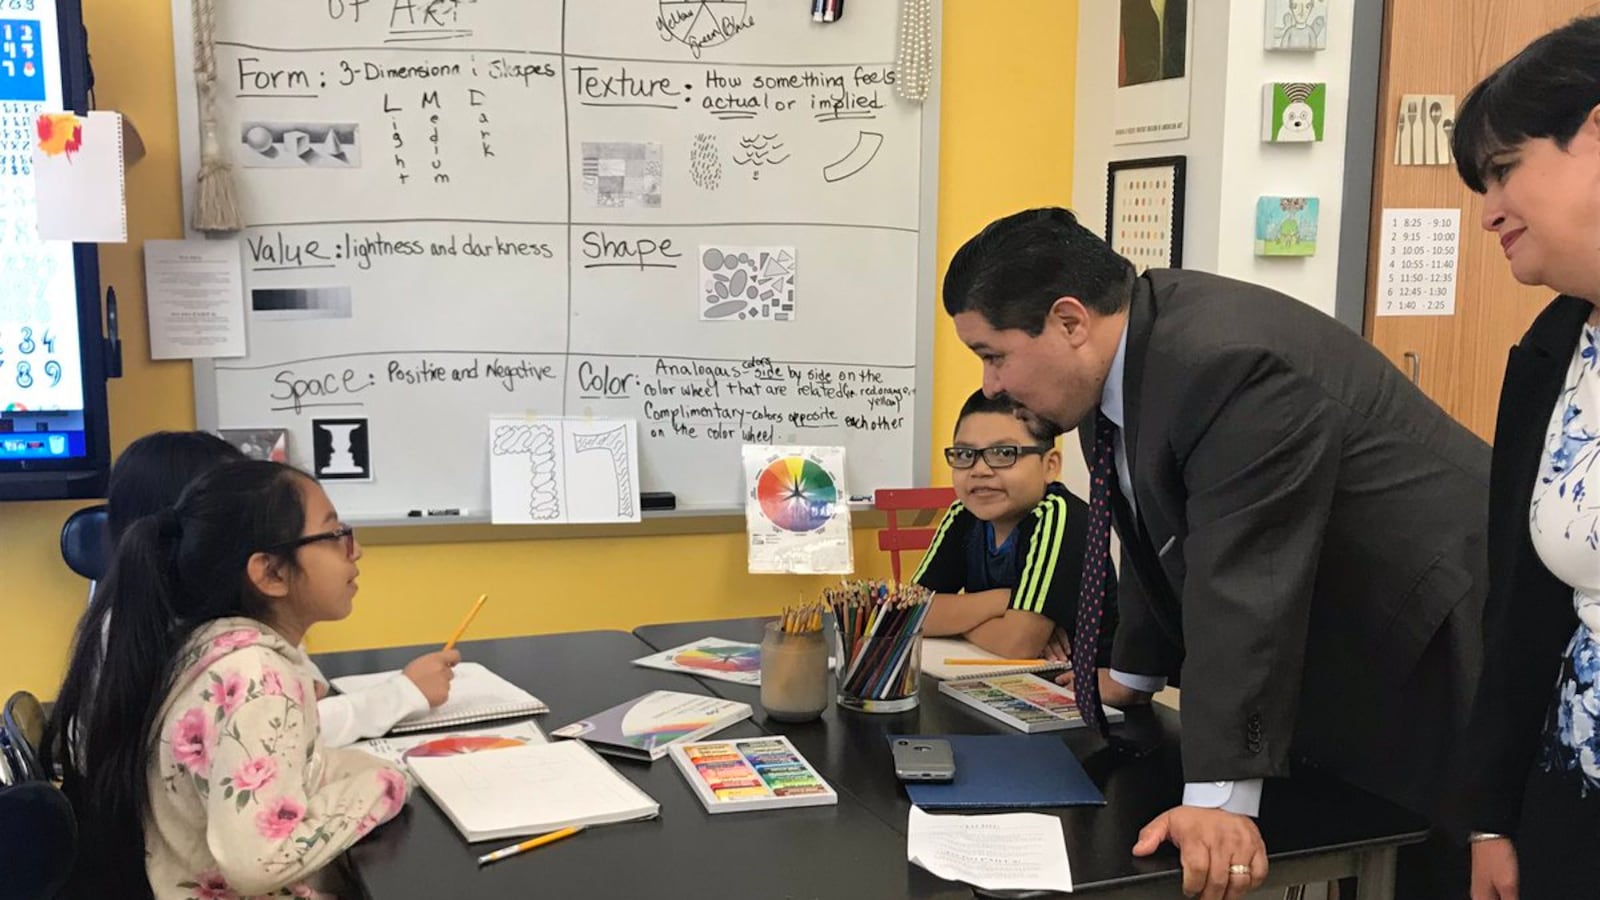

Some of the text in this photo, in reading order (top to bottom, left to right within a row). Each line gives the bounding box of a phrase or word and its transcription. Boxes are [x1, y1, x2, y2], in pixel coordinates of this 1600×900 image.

[706, 66, 896, 99] How something feels
[702, 90, 884, 118] actual or implied
[1393, 219, 1397, 227] 1
[1403, 219, 1422, 227] 8:25
[1433, 219, 1452, 227] 9:10
[430, 235, 457, 256] and
[462, 233, 554, 258] darkness
[1391, 232, 1397, 241] 2
[1402, 232, 1421, 241] 9:15
[1433, 232, 1456, 241] 10:00
[582, 231, 682, 271] Shape
[1390, 246, 1396, 255] 3
[1402, 246, 1425, 255] 10:05
[1432, 246, 1455, 255] 10:50
[1389, 260, 1395, 269] 4
[1401, 260, 1424, 269] 10:55
[1431, 260, 1454, 269] 11:40
[1389, 273, 1394, 282] 5
[1400, 273, 1423, 282] 11:50
[1430, 273, 1453, 282] 12:35
[1387, 288, 1393, 296] 6
[1399, 288, 1422, 296] 12:45
[1429, 288, 1447, 296] 1:30
[1387, 301, 1393, 310] 7
[1399, 301, 1417, 310] 1:40
[1427, 301, 1445, 310] 2:25
[451, 358, 479, 379] and
[486, 358, 557, 392] Negative
[754, 366, 785, 379] side
[787, 365, 802, 386] by
[807, 368, 832, 381] side
[839, 371, 857, 381] on
[859, 368, 884, 384] the
[644, 379, 677, 396] color
[681, 379, 720, 397] wheel
[726, 380, 763, 397] that
[765, 385, 788, 396] are
[787, 406, 839, 428] opposite
[871, 415, 905, 431] other
[650, 428, 666, 438] on
[675, 421, 698, 438] the
[706, 421, 735, 440] color
